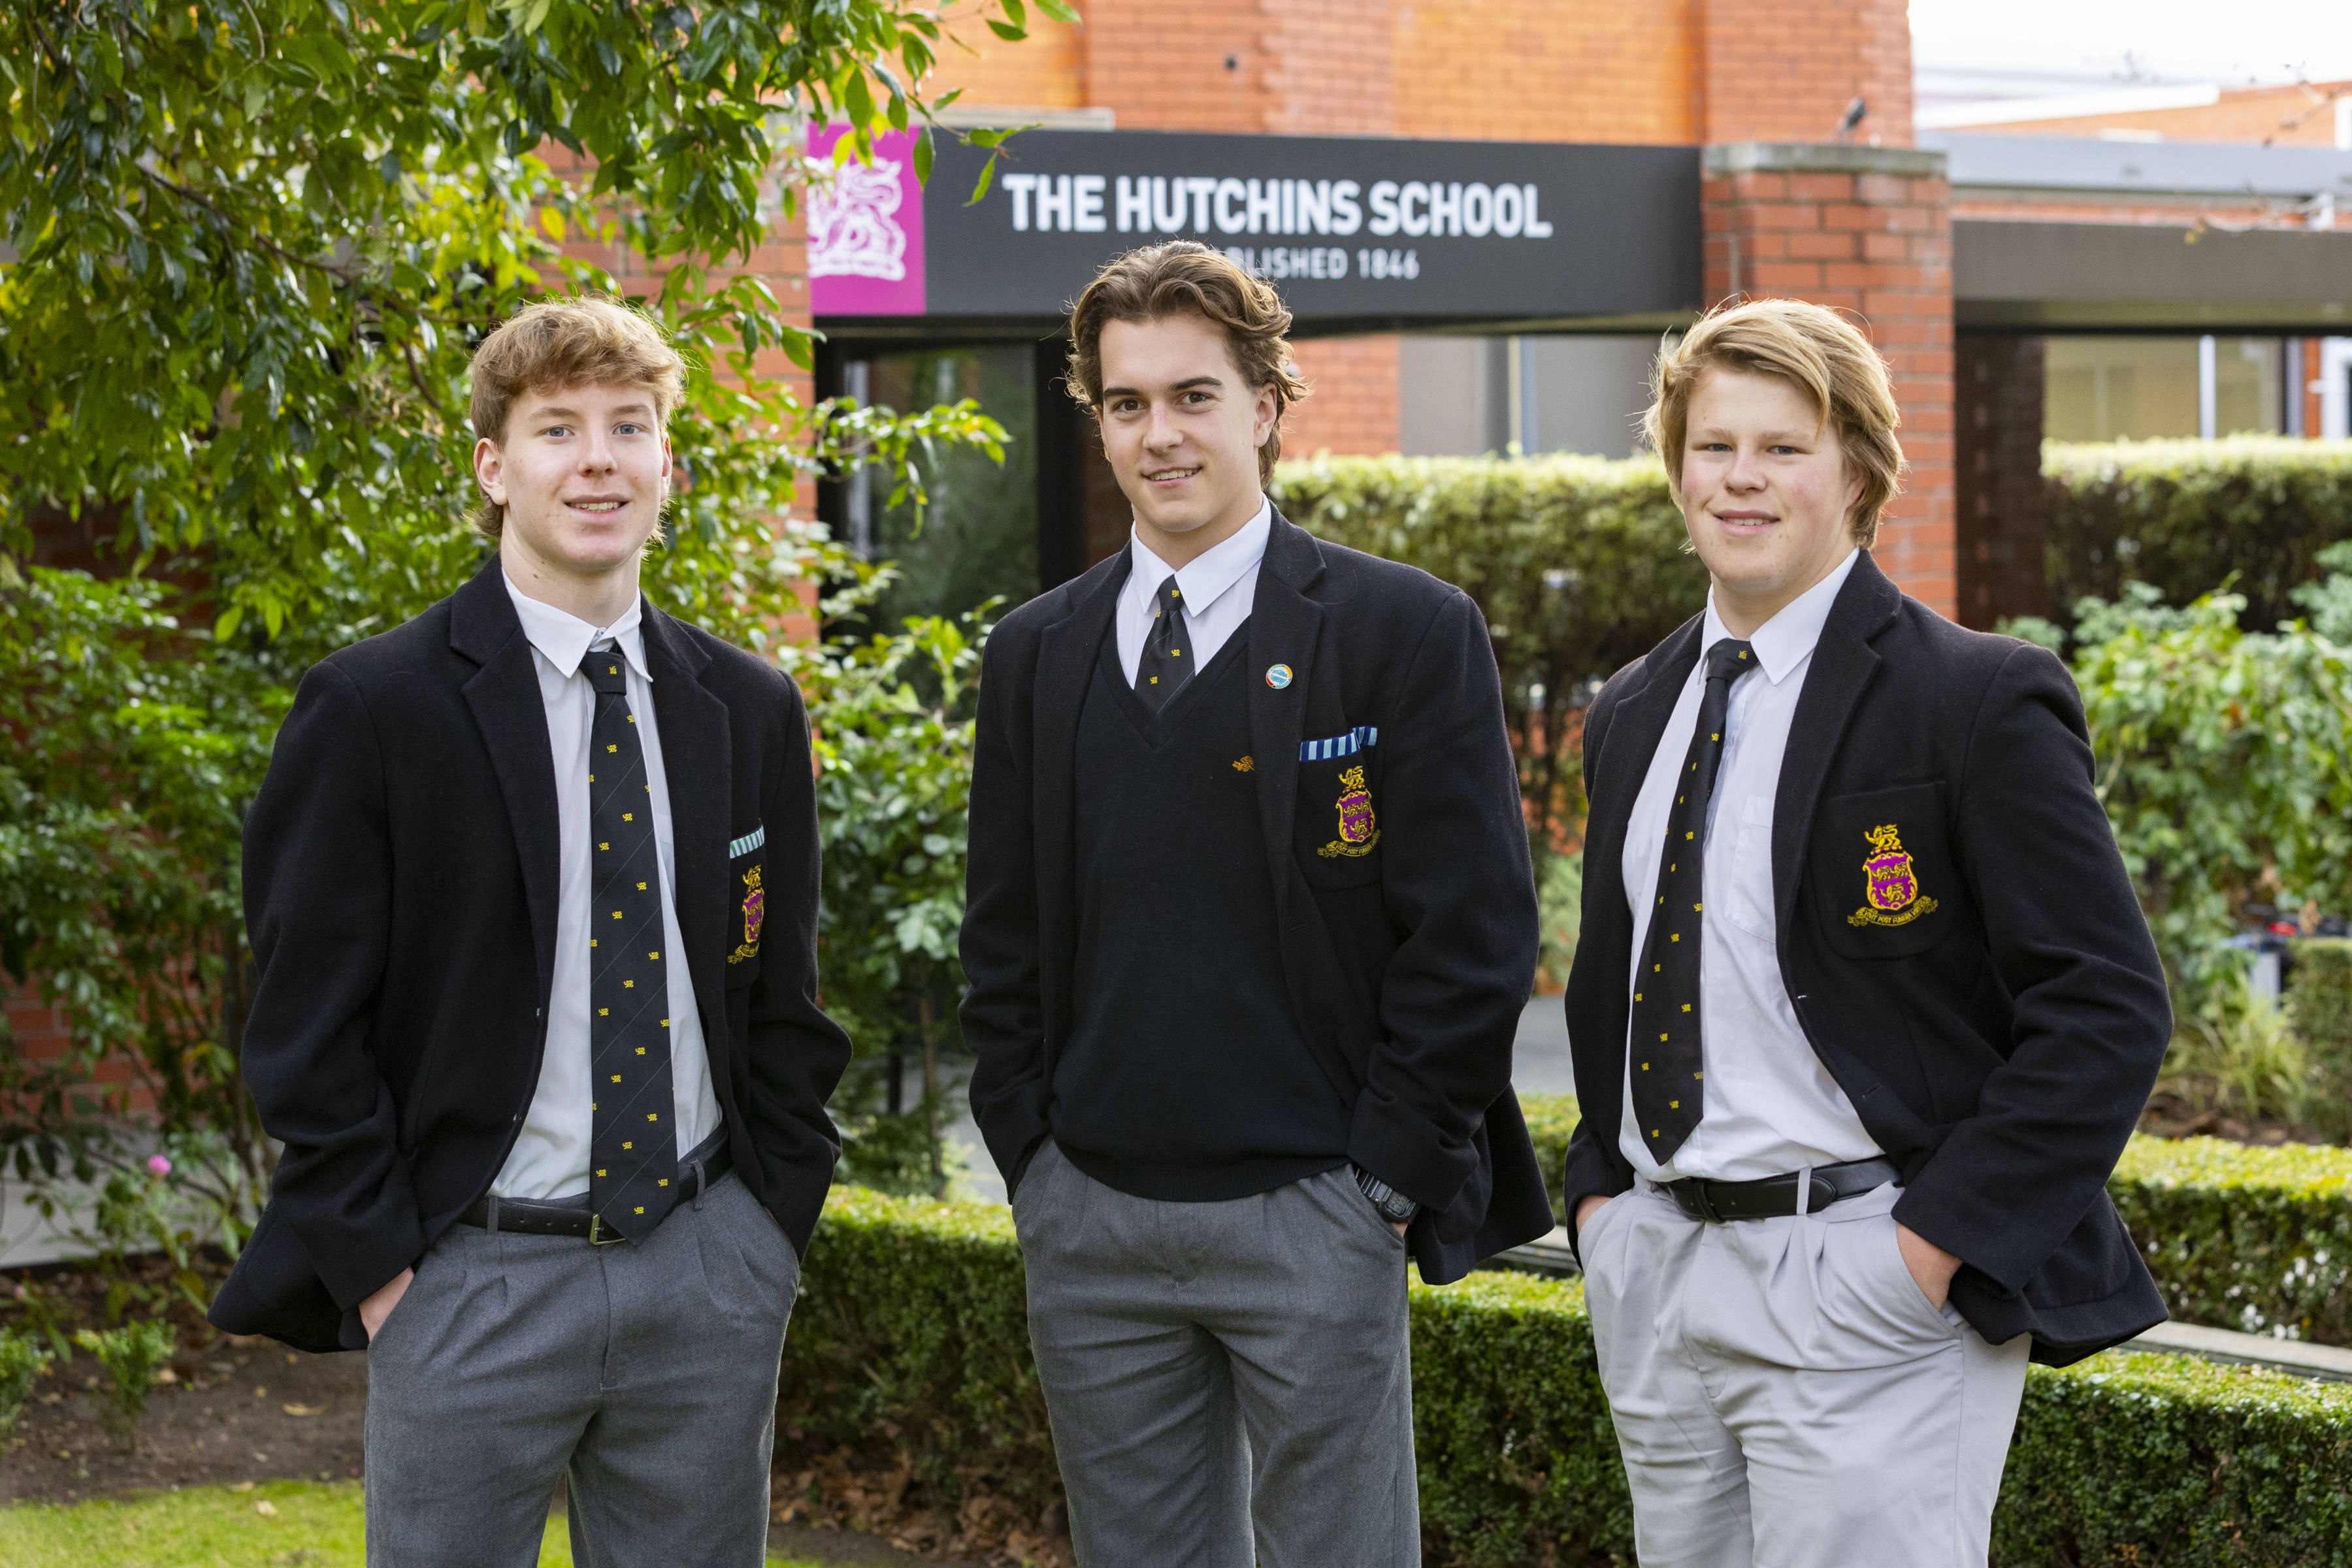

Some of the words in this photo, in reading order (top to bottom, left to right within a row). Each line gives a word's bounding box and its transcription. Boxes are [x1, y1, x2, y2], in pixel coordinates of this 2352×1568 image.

[1002, 173, 1107, 232] THE
[1115, 175, 1363, 236] HUTCHINS
[1368, 180, 1554, 238] SCHOOL
[1356, 248, 1420, 280] 1846
